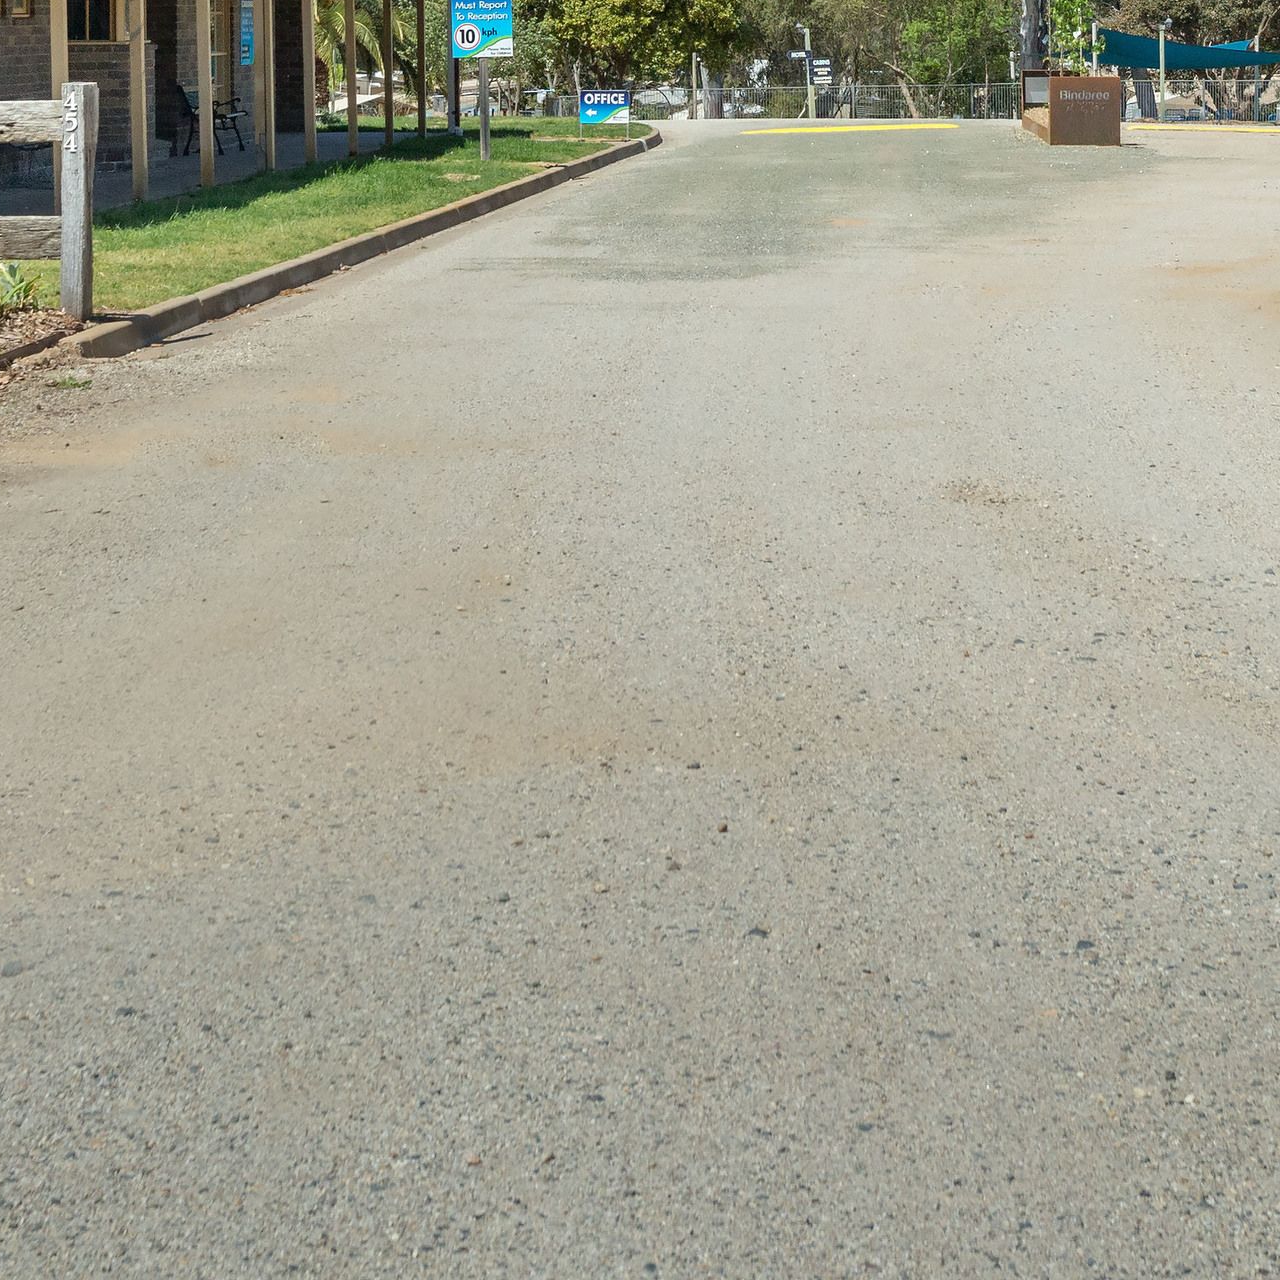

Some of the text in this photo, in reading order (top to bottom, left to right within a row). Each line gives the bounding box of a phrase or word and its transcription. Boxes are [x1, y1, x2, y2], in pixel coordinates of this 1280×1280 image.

[479, 1, 507, 10] Report
[455, 12, 508, 21] To Reception
[460, 27, 498, 44] 10 kph
[584, 93, 625, 105] OFFICE
[64, 91, 79, 153] 454
